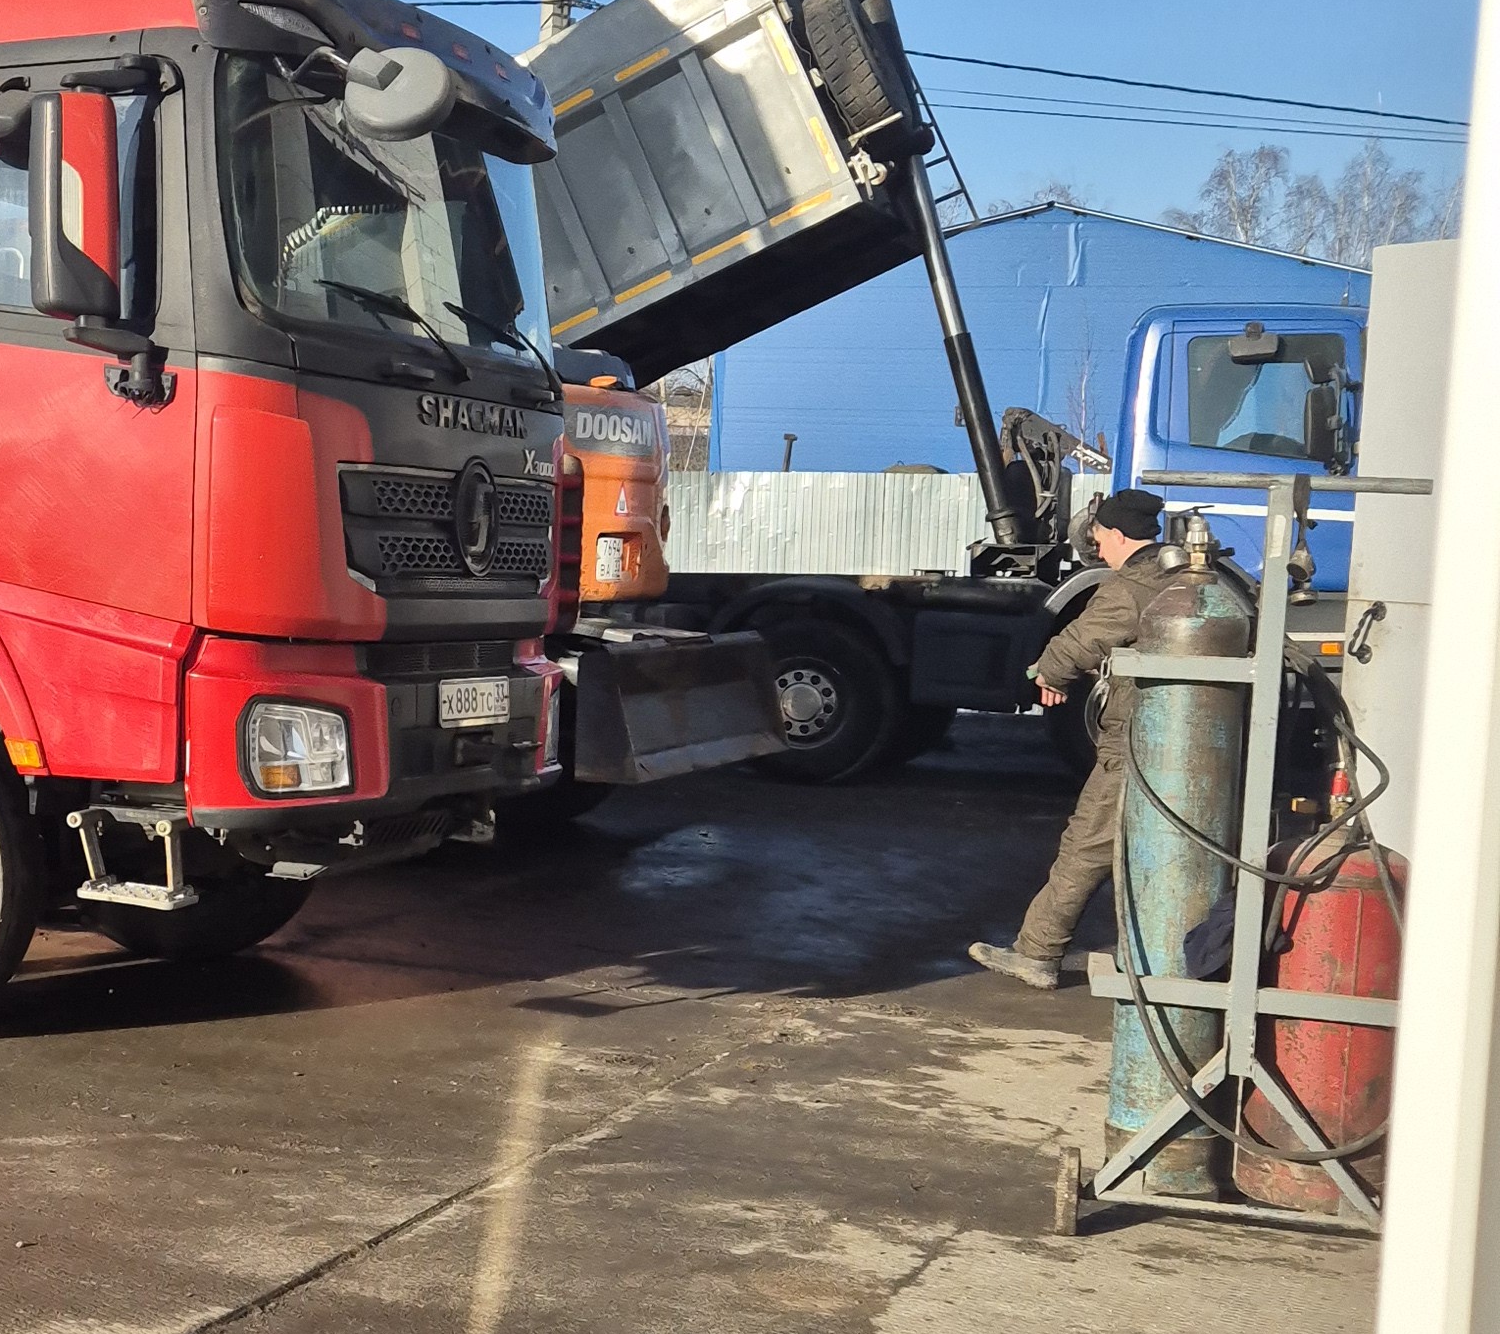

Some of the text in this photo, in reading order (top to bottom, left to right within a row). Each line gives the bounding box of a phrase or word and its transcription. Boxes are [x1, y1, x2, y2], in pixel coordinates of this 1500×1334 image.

[417, 393, 529, 439] SHACMAN
[575, 411, 652, 447] DOOSAN
[523, 448, 556, 478] X3000
